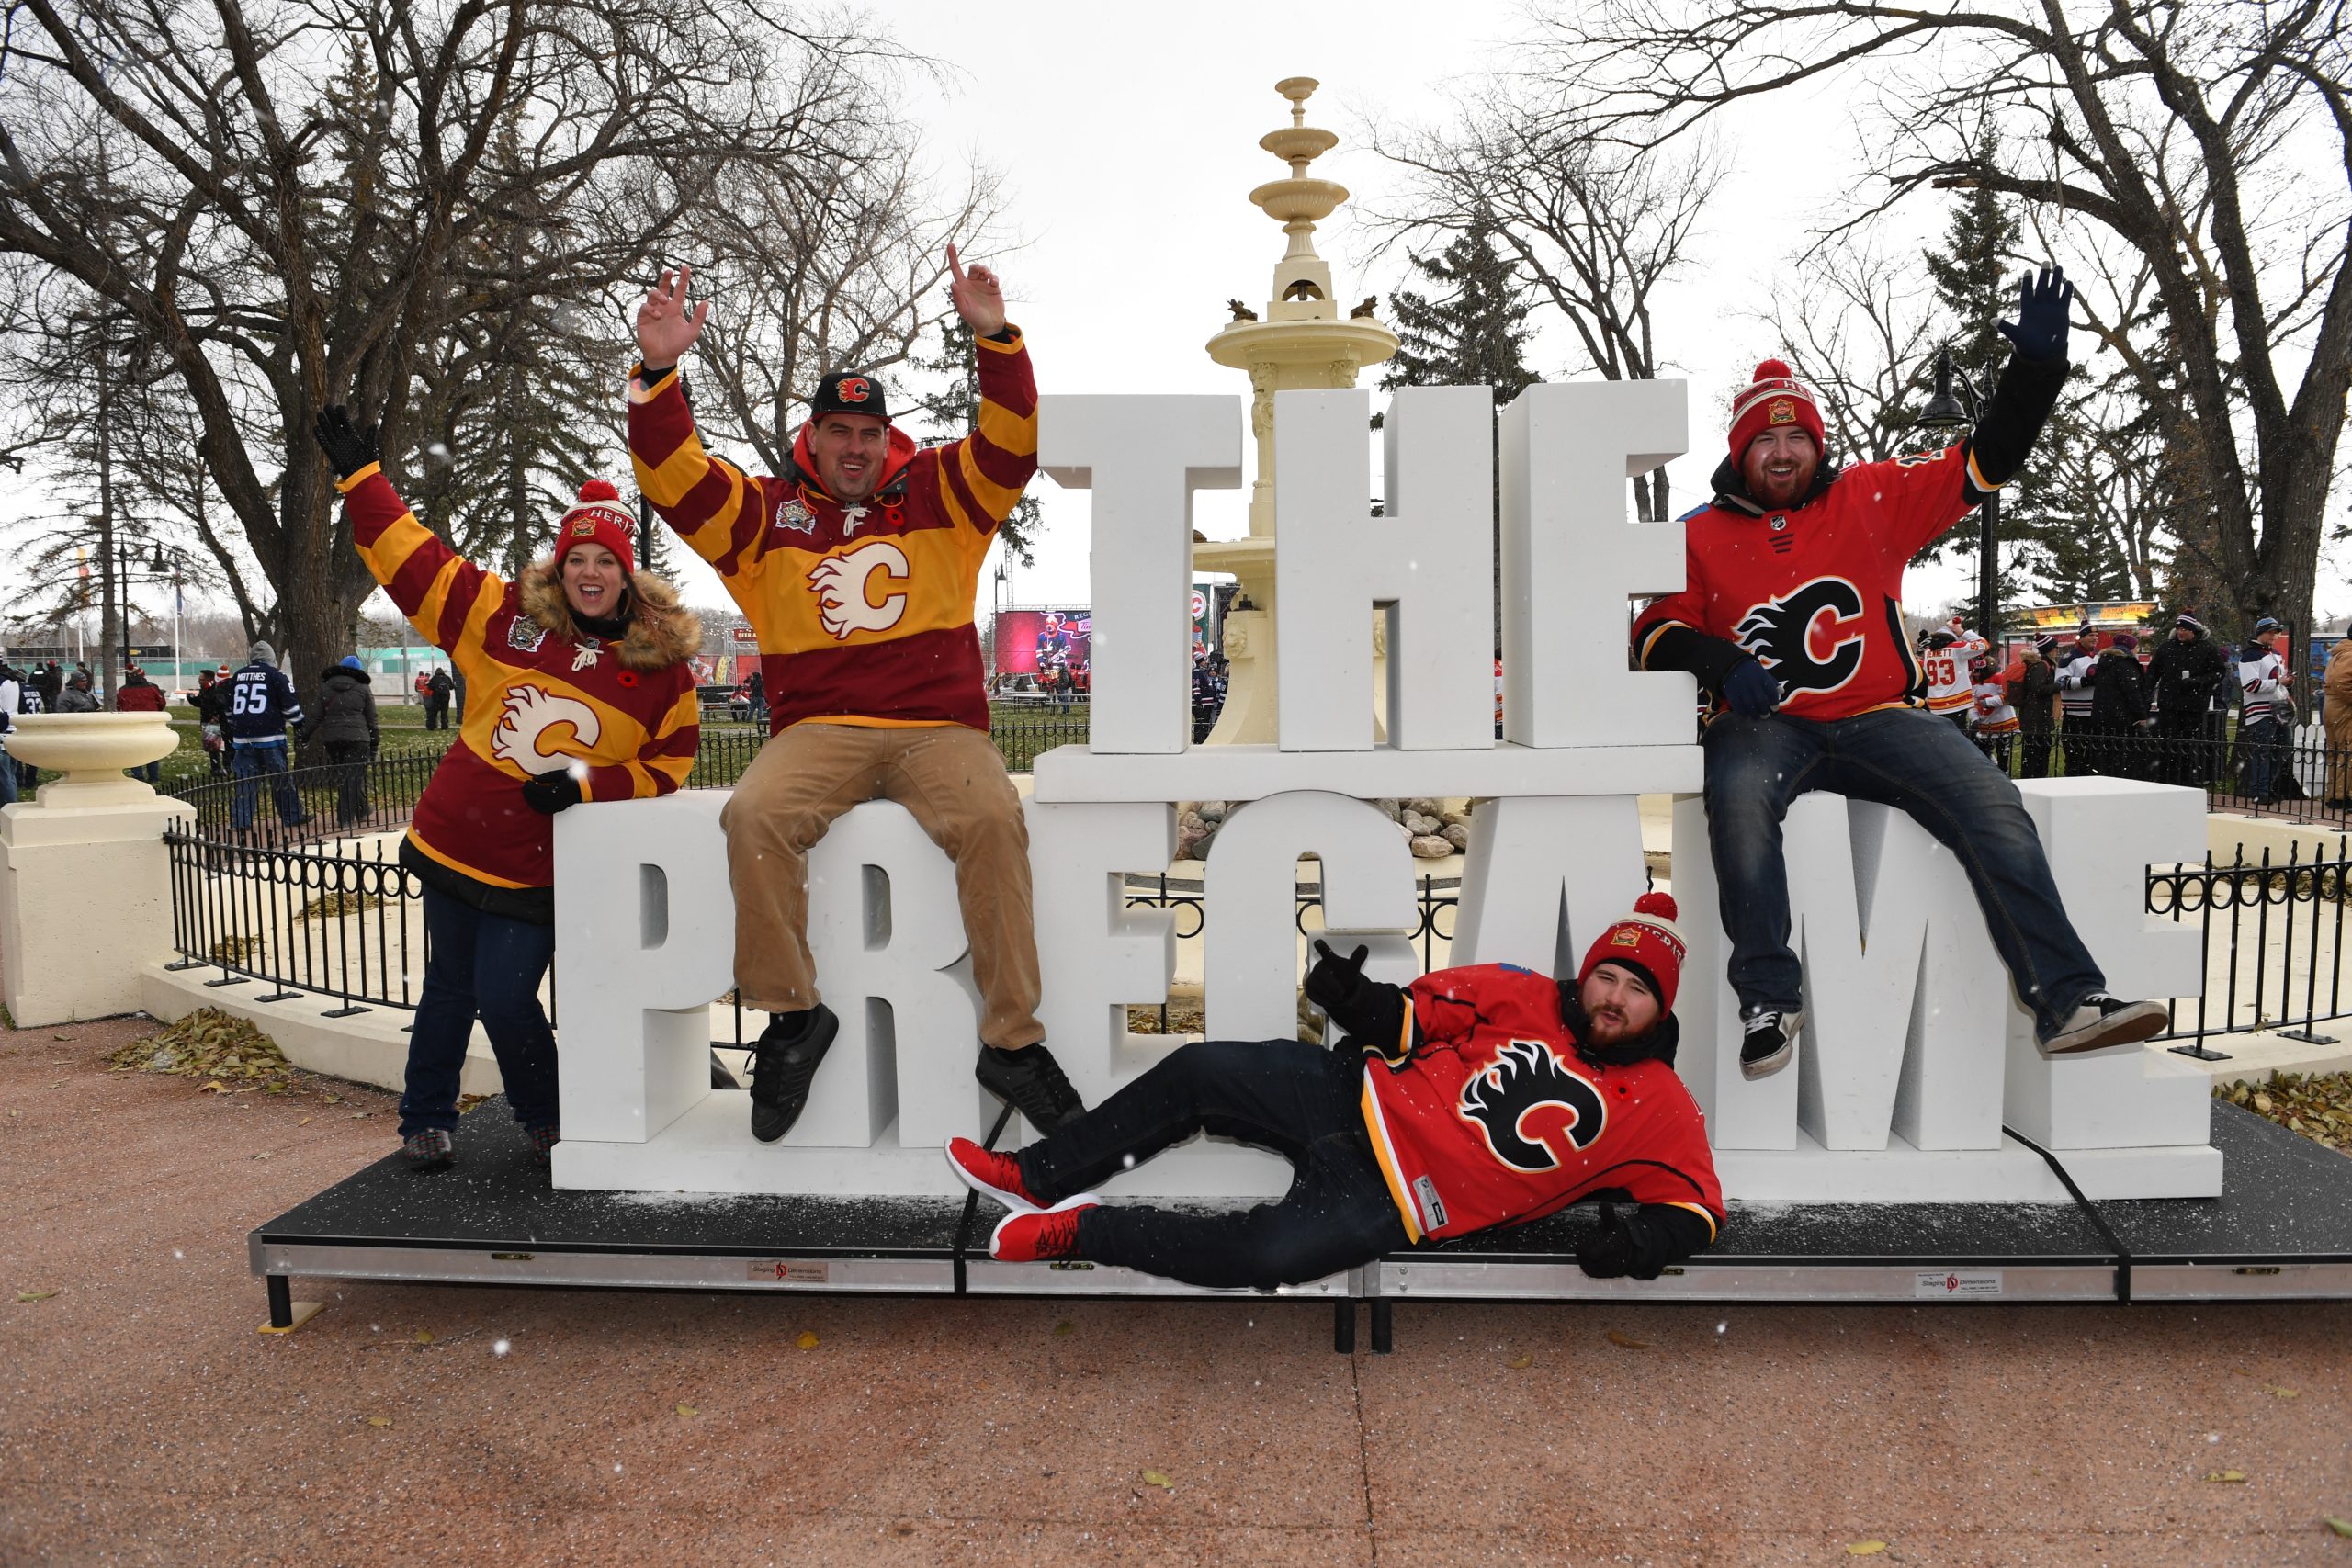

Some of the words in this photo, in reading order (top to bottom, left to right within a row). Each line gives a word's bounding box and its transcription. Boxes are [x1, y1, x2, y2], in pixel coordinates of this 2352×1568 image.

[1038, 378, 1698, 754] THE
[1926, 659, 1956, 687] 93
[232, 683, 267, 715] 65
